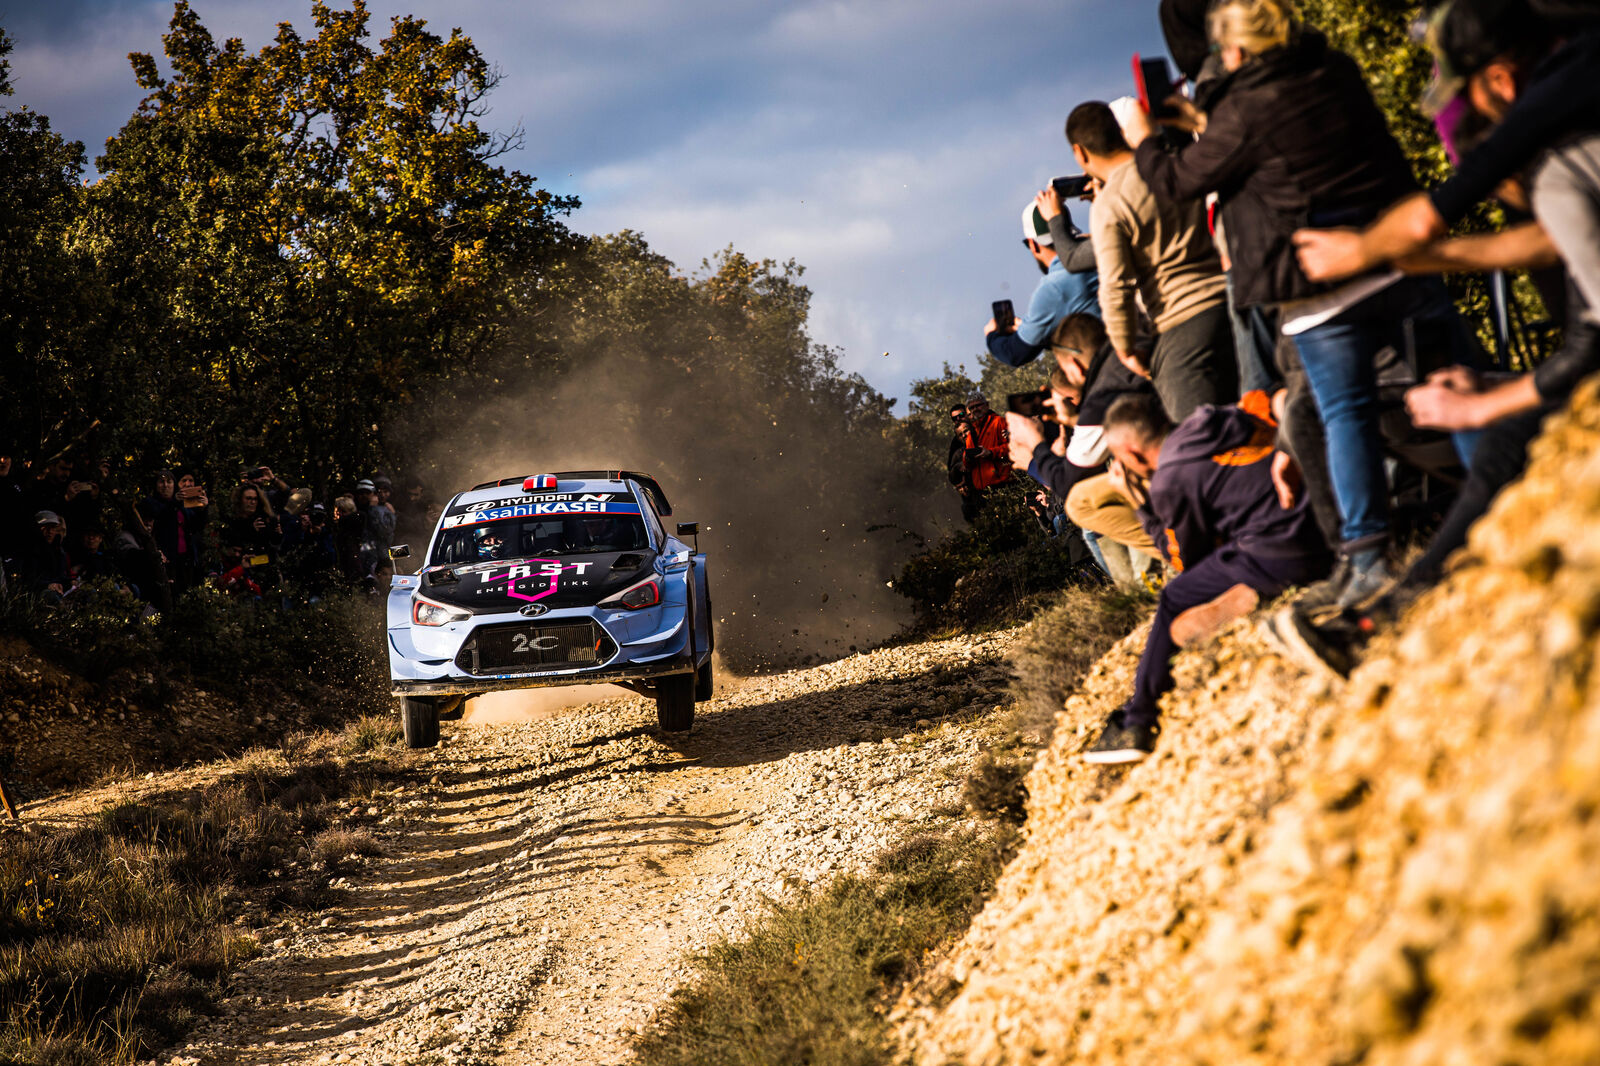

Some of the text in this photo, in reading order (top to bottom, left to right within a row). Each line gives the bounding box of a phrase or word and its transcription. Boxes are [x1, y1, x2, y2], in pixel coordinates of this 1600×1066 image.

[500, 494, 572, 507] HYUNDAI
[456, 514, 466, 525] 7
[476, 580, 589, 595] ENERGIDRIKK
